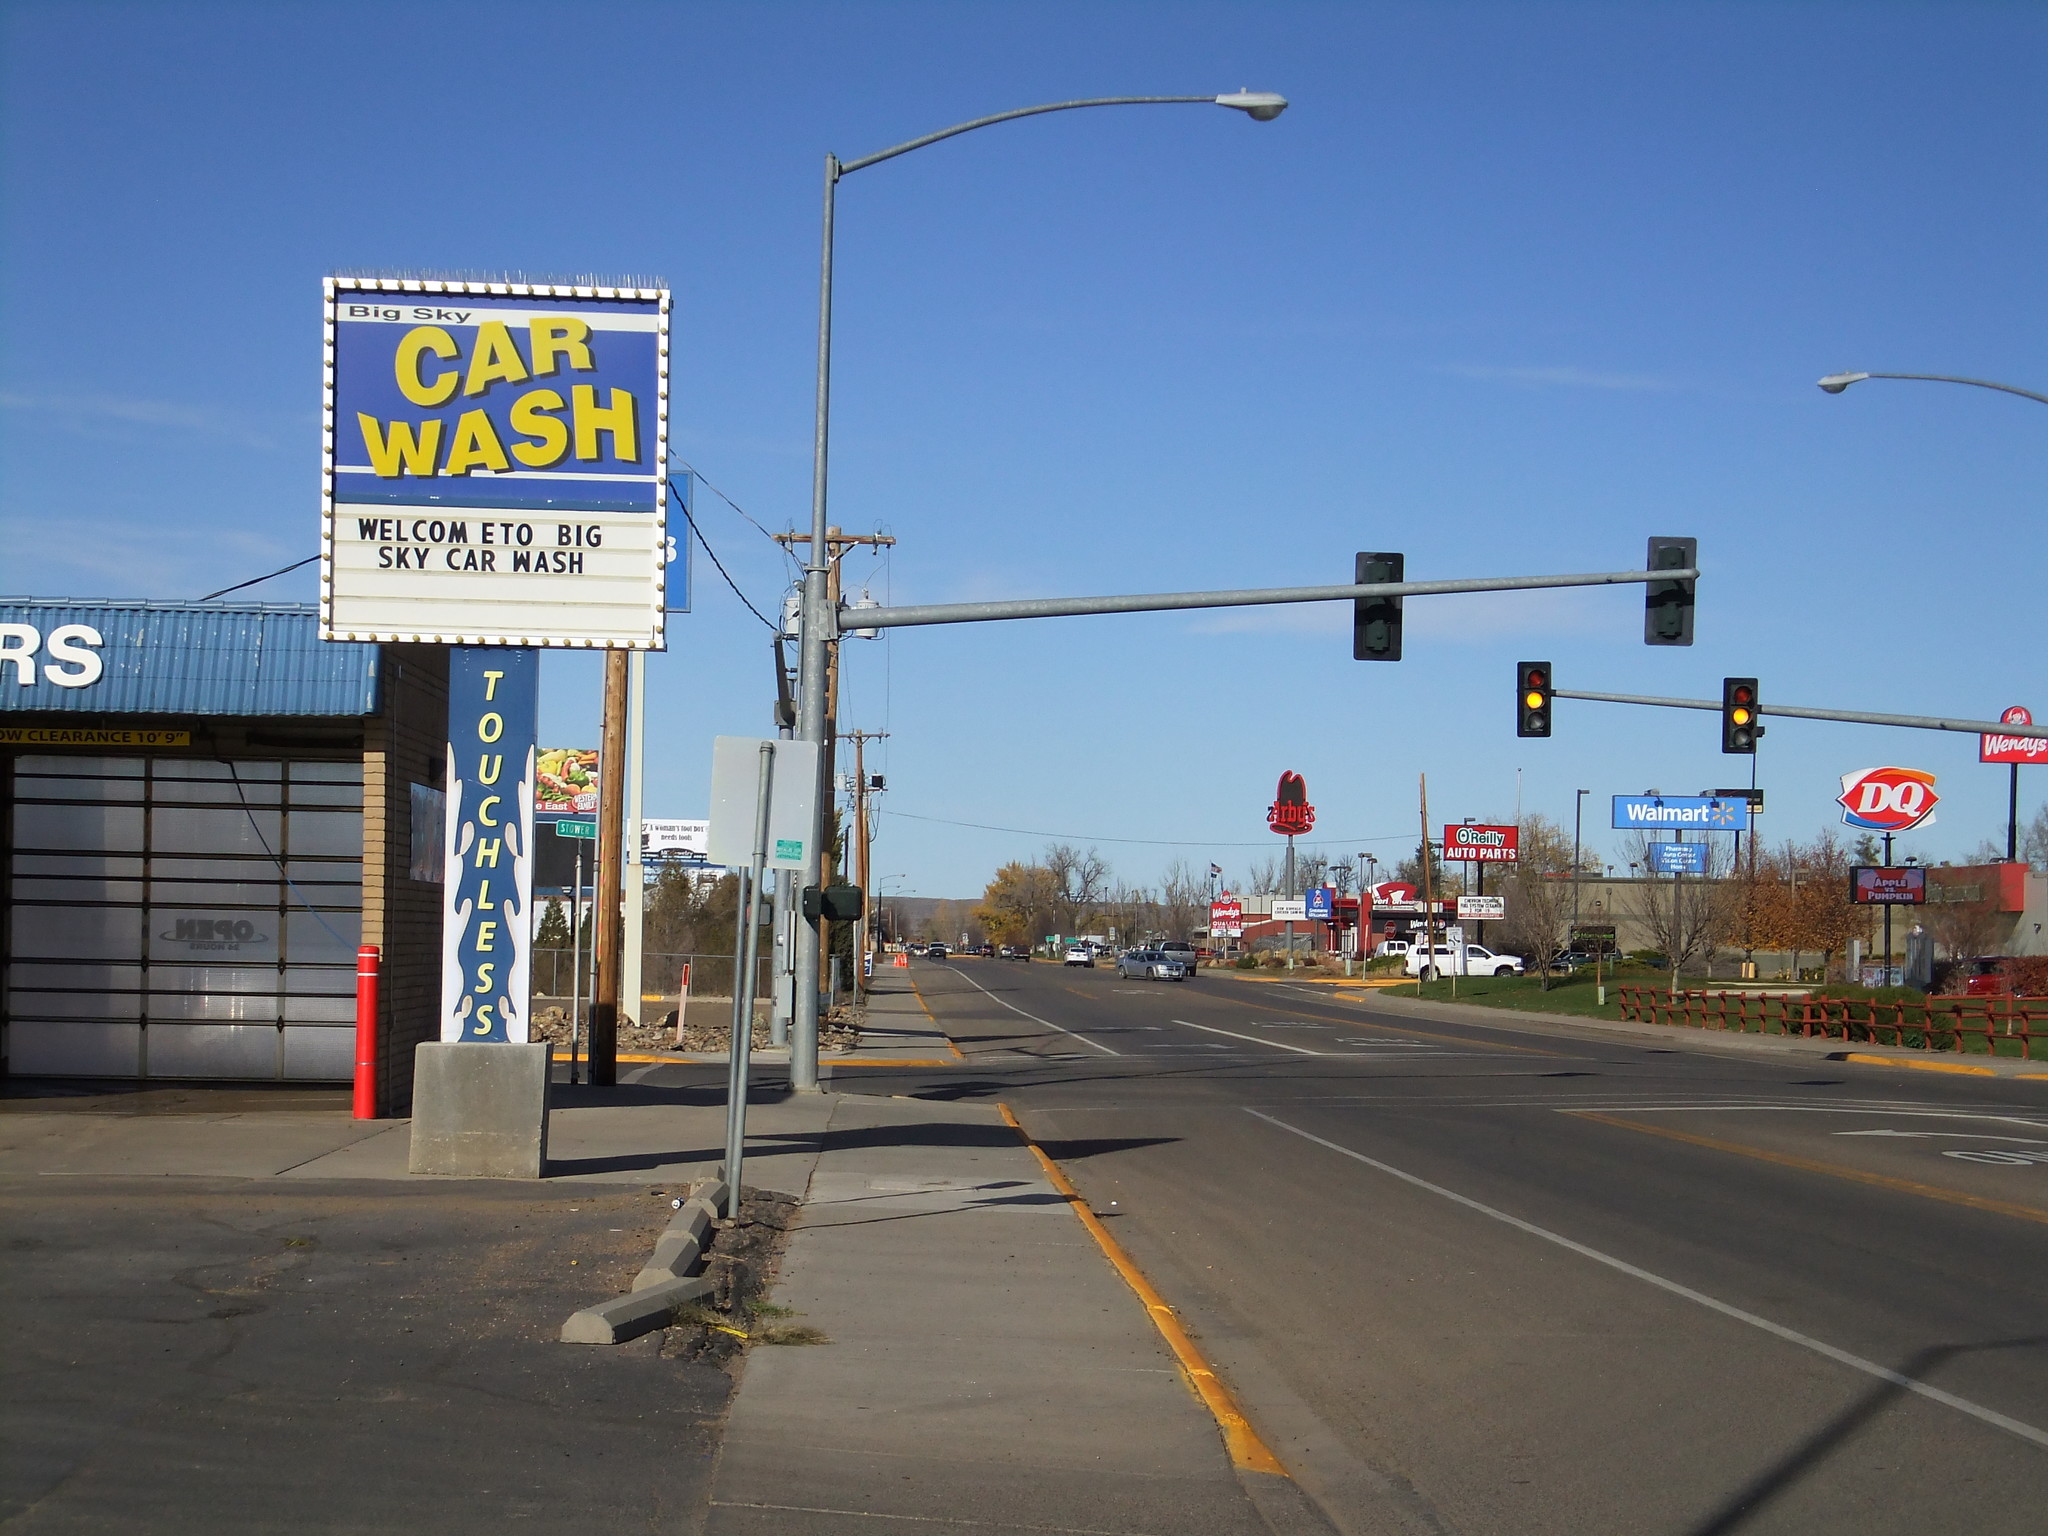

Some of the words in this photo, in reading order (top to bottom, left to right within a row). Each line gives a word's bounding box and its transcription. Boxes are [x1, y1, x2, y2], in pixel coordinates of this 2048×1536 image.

[349, 305, 401, 321] Big
[413, 307, 472, 324] Sky
[395, 317, 594, 407] CAR
[357, 384, 637, 478] WASH
[358, 518, 468, 545] WELCOM
[482, 522, 534, 546] ETO
[558, 525, 603, 548] BIG
[378, 546, 430, 570] SKY
[446, 549, 496, 572] CAR
[512, 550, 585, 574] WASH
[0, 624, 104, 687] RS
[28, 730, 131, 743] CLEARANCE
[545, 802, 568, 811] East
[1626, 803, 1710, 822] Walmart
[1857, 781, 1925, 817] DQ
[1266, 799, 1316, 828] Arby's
[1457, 829, 1504, 846] O'Reilly
[473, 671, 505, 1036] TOUCHLESS
[1447, 847, 1476, 858] AUTO
[1480, 848, 1516, 859] PARTS
[1868, 890, 1913, 900] PUMPKIN
